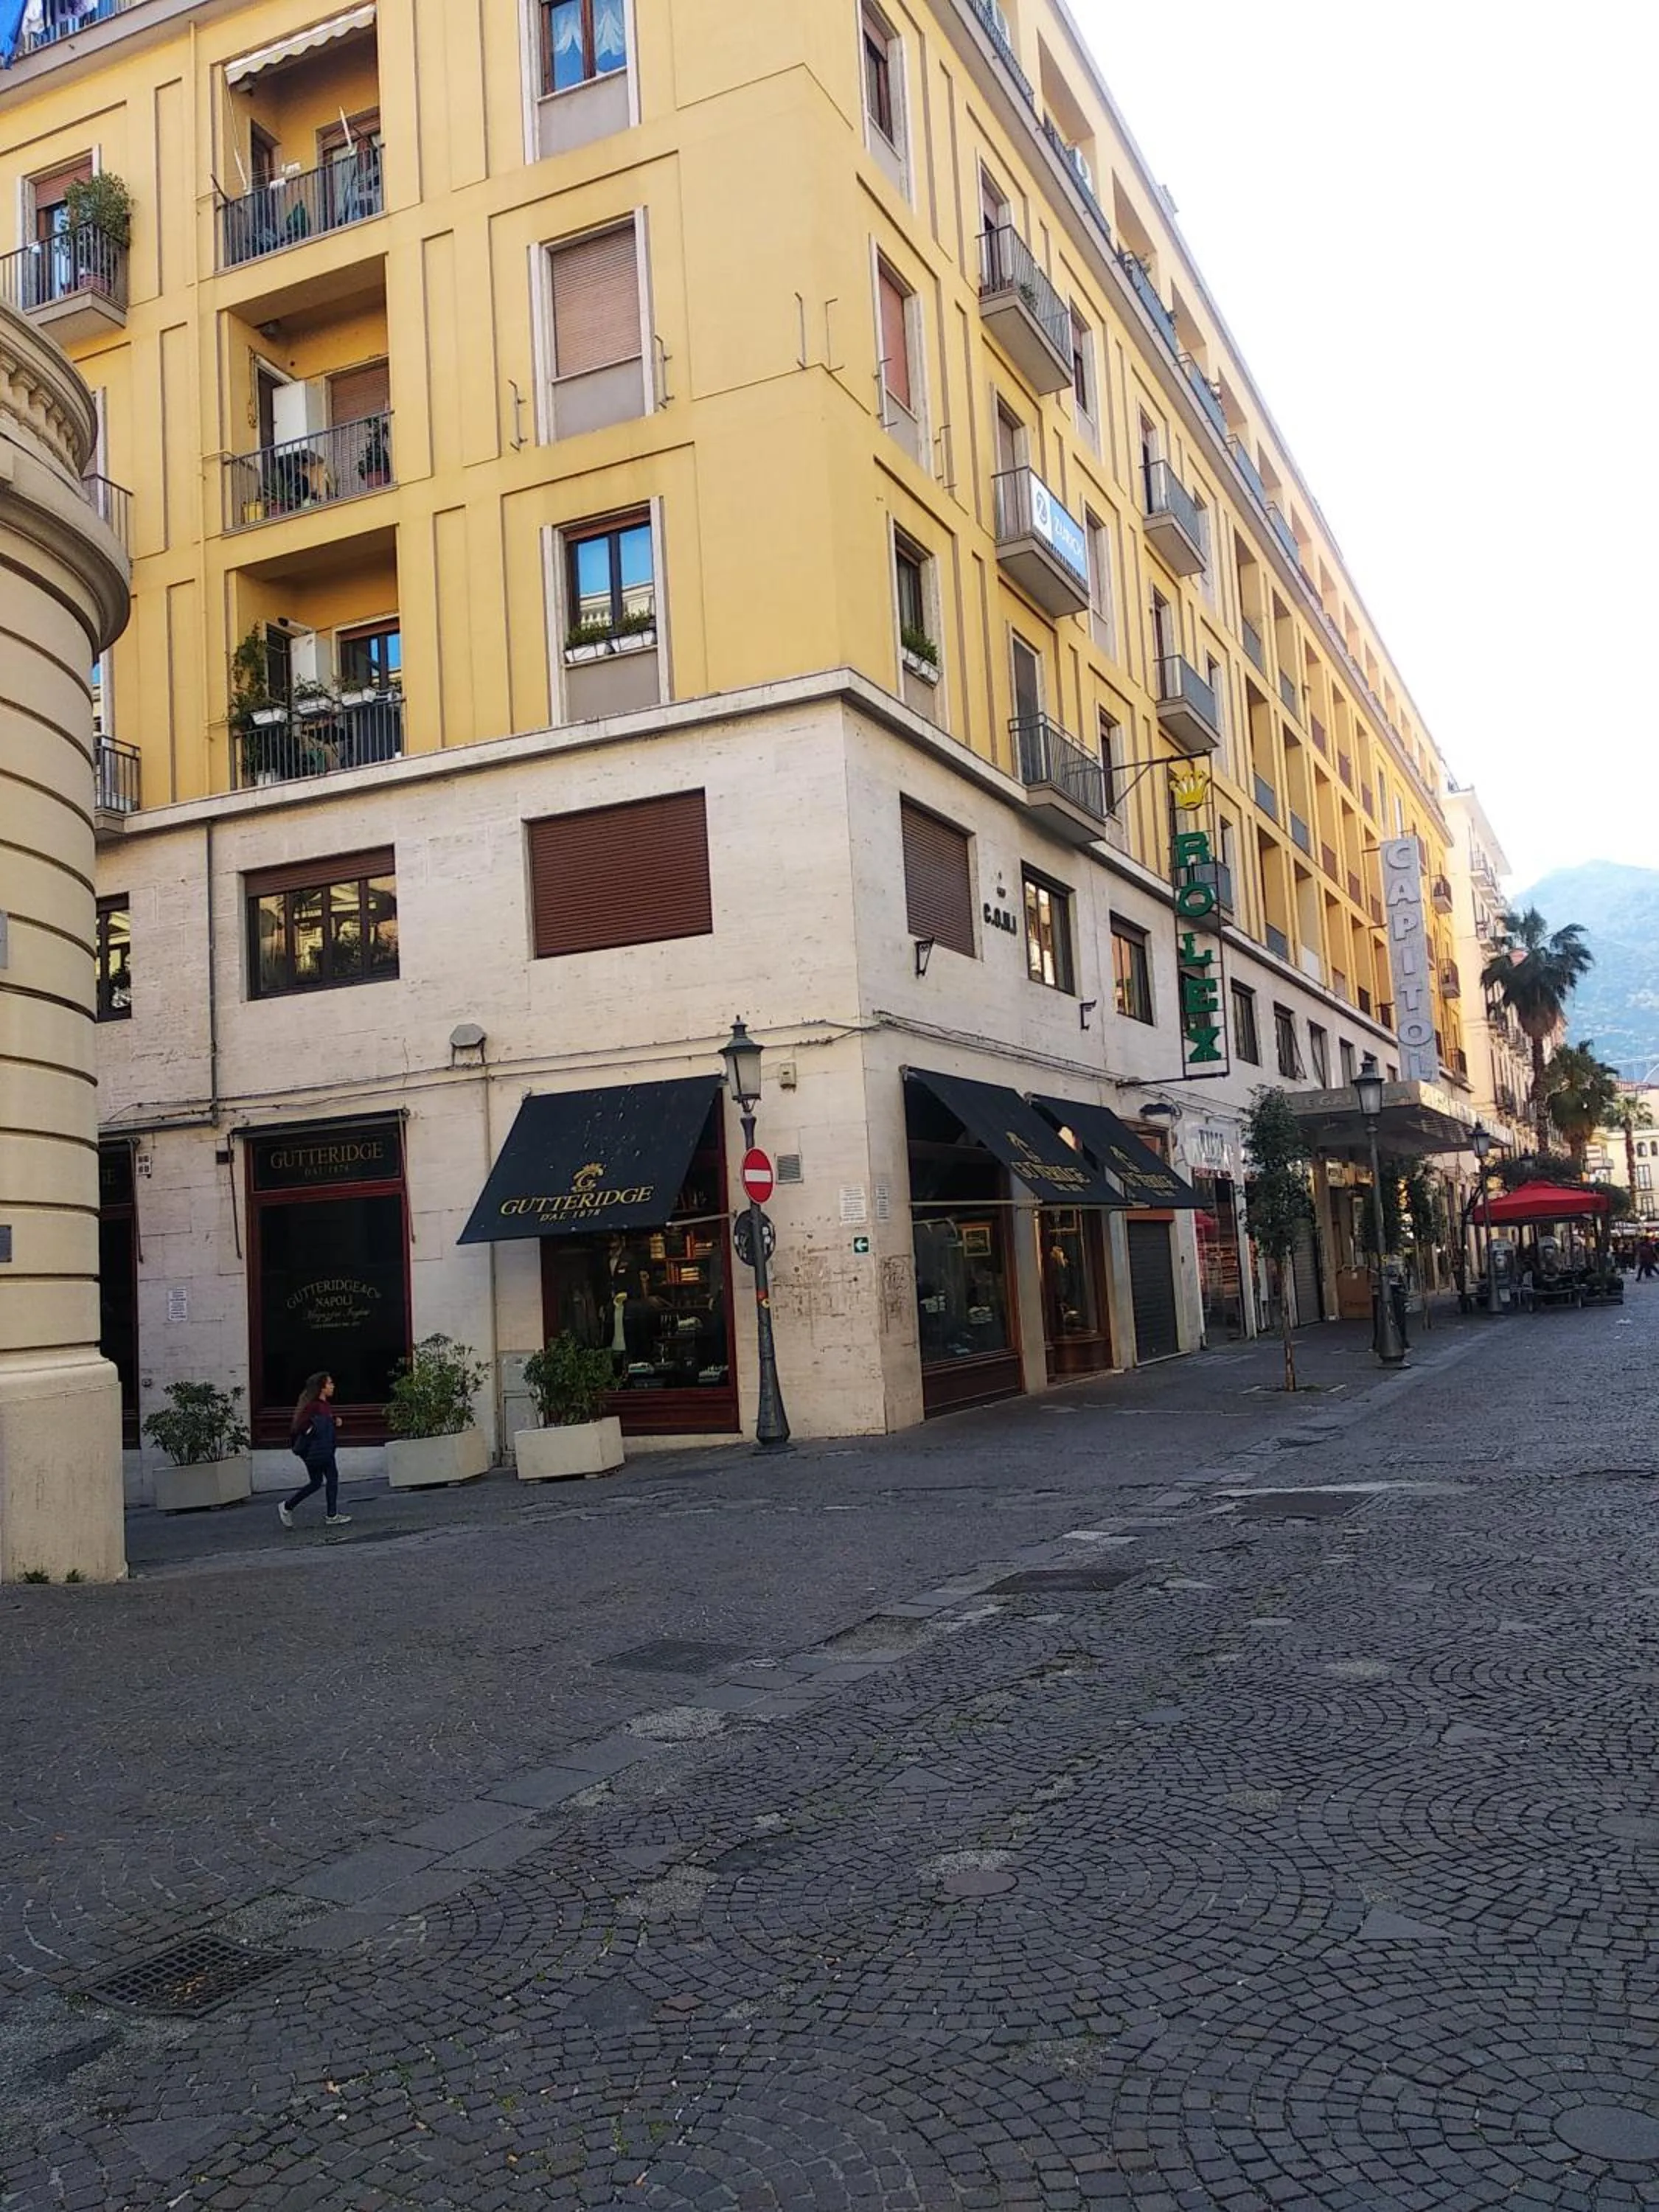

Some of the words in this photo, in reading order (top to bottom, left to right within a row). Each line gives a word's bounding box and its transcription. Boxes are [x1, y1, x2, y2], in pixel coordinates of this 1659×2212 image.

[1170, 831, 1222, 1063] ROLEX
[1385, 846, 1433, 1082] CAPITOL
[271, 1142, 384, 1169] GUTTERIDGE
[501, 1186, 654, 1215] GUTTERIDGE
[540, 1212, 567, 1222] DAL
